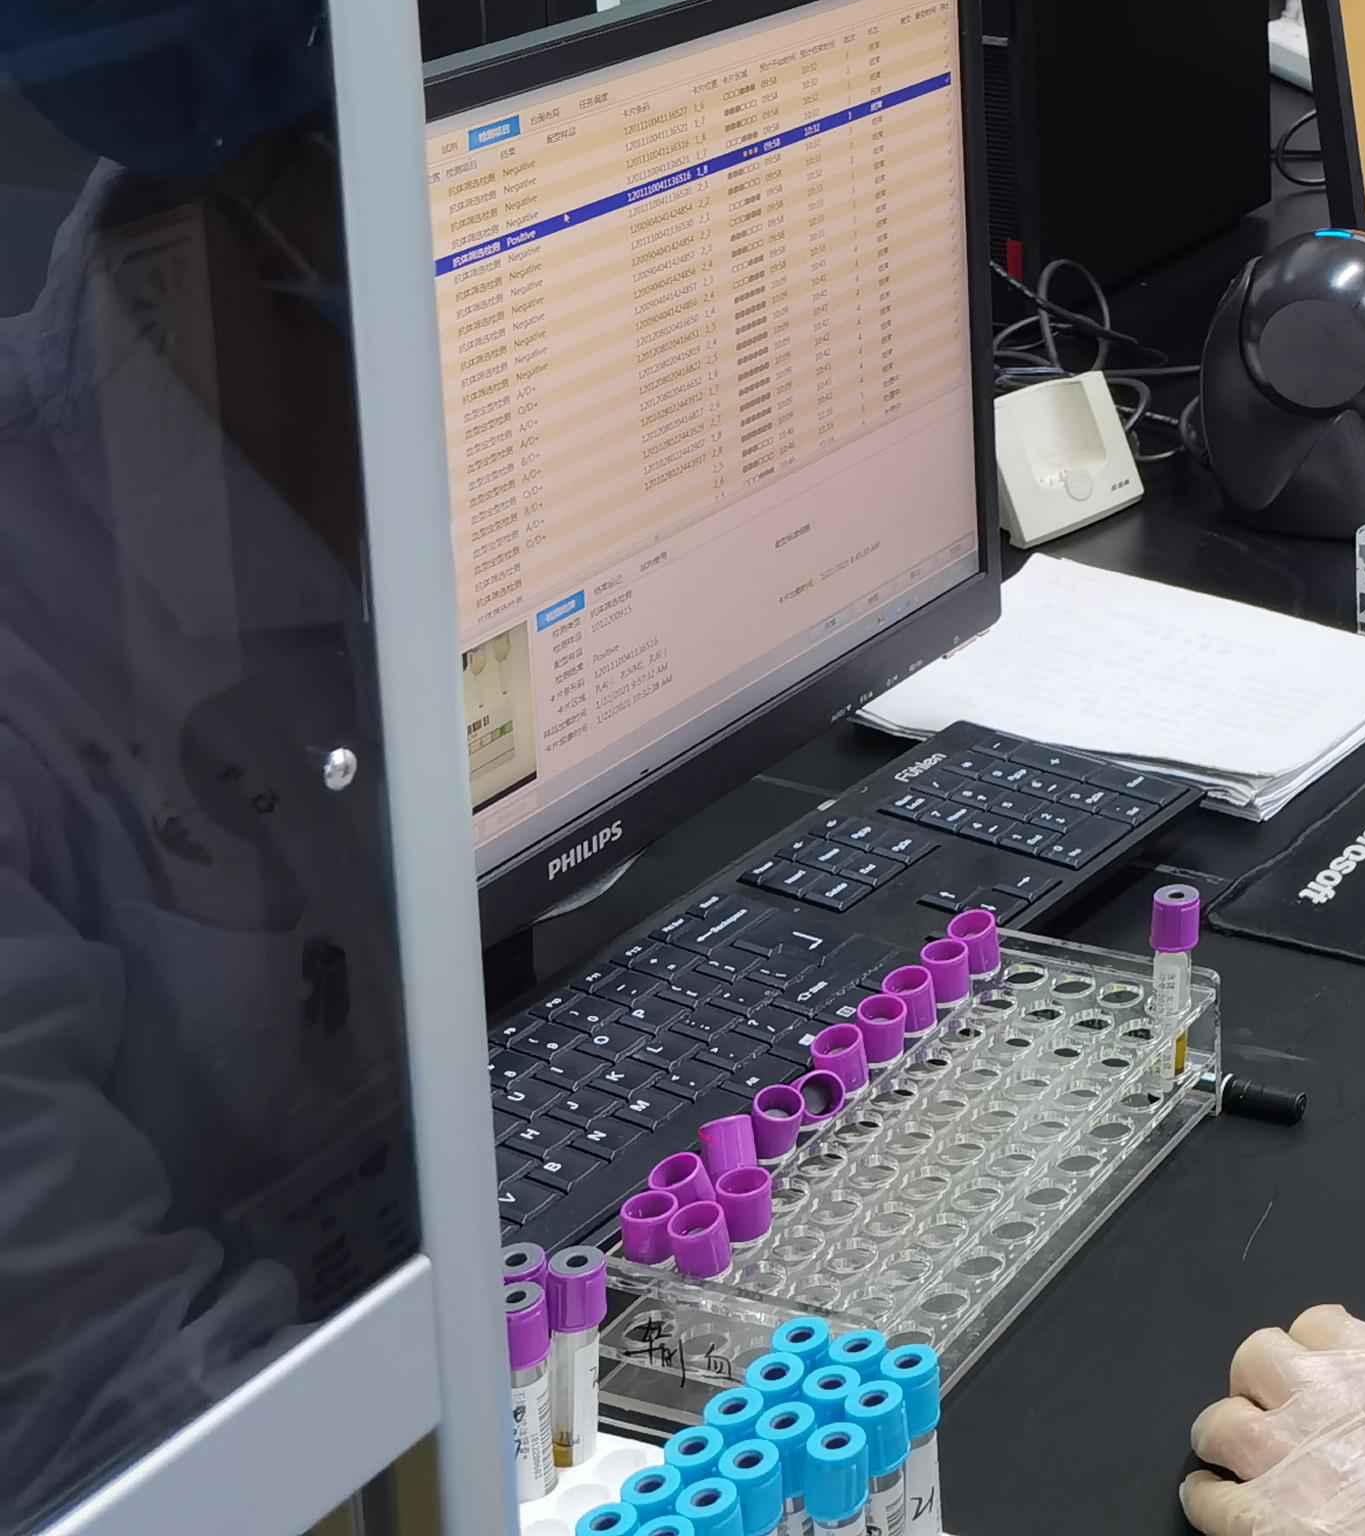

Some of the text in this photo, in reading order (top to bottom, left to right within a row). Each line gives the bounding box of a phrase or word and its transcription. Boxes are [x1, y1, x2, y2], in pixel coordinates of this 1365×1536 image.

[501, 157, 536, 179] Negative
[503, 174, 538, 197] Negative
[506, 227, 536, 247] Positive
[763, 136, 780, 152] 09:58
[504, 191, 539, 214] Negative
[508, 259, 543, 282] Negative
[509, 276, 544, 300] Negative
[510, 293, 545, 317] Negative
[512, 310, 546, 334] Negative
[513, 327, 547, 351] Negative
[514, 344, 548, 368] Negative
[592, 641, 619, 665] Positive
[546, 820, 624, 881] PHILIPS
[631, 1007, 646, 1019] P
[592, 1034, 609, 1045] O
[645, 1045, 664, 1055] L
[605, 1068, 625, 1082] K
[506, 1090, 526, 1102] U
[566, 1100, 580, 1111] J
[629, 1099, 651, 1113] M
[519, 1127, 541, 1140] H
[586, 1129, 608, 1142] N
[543, 1160, 563, 1173] B
[497, 1191, 517, 1204] V
